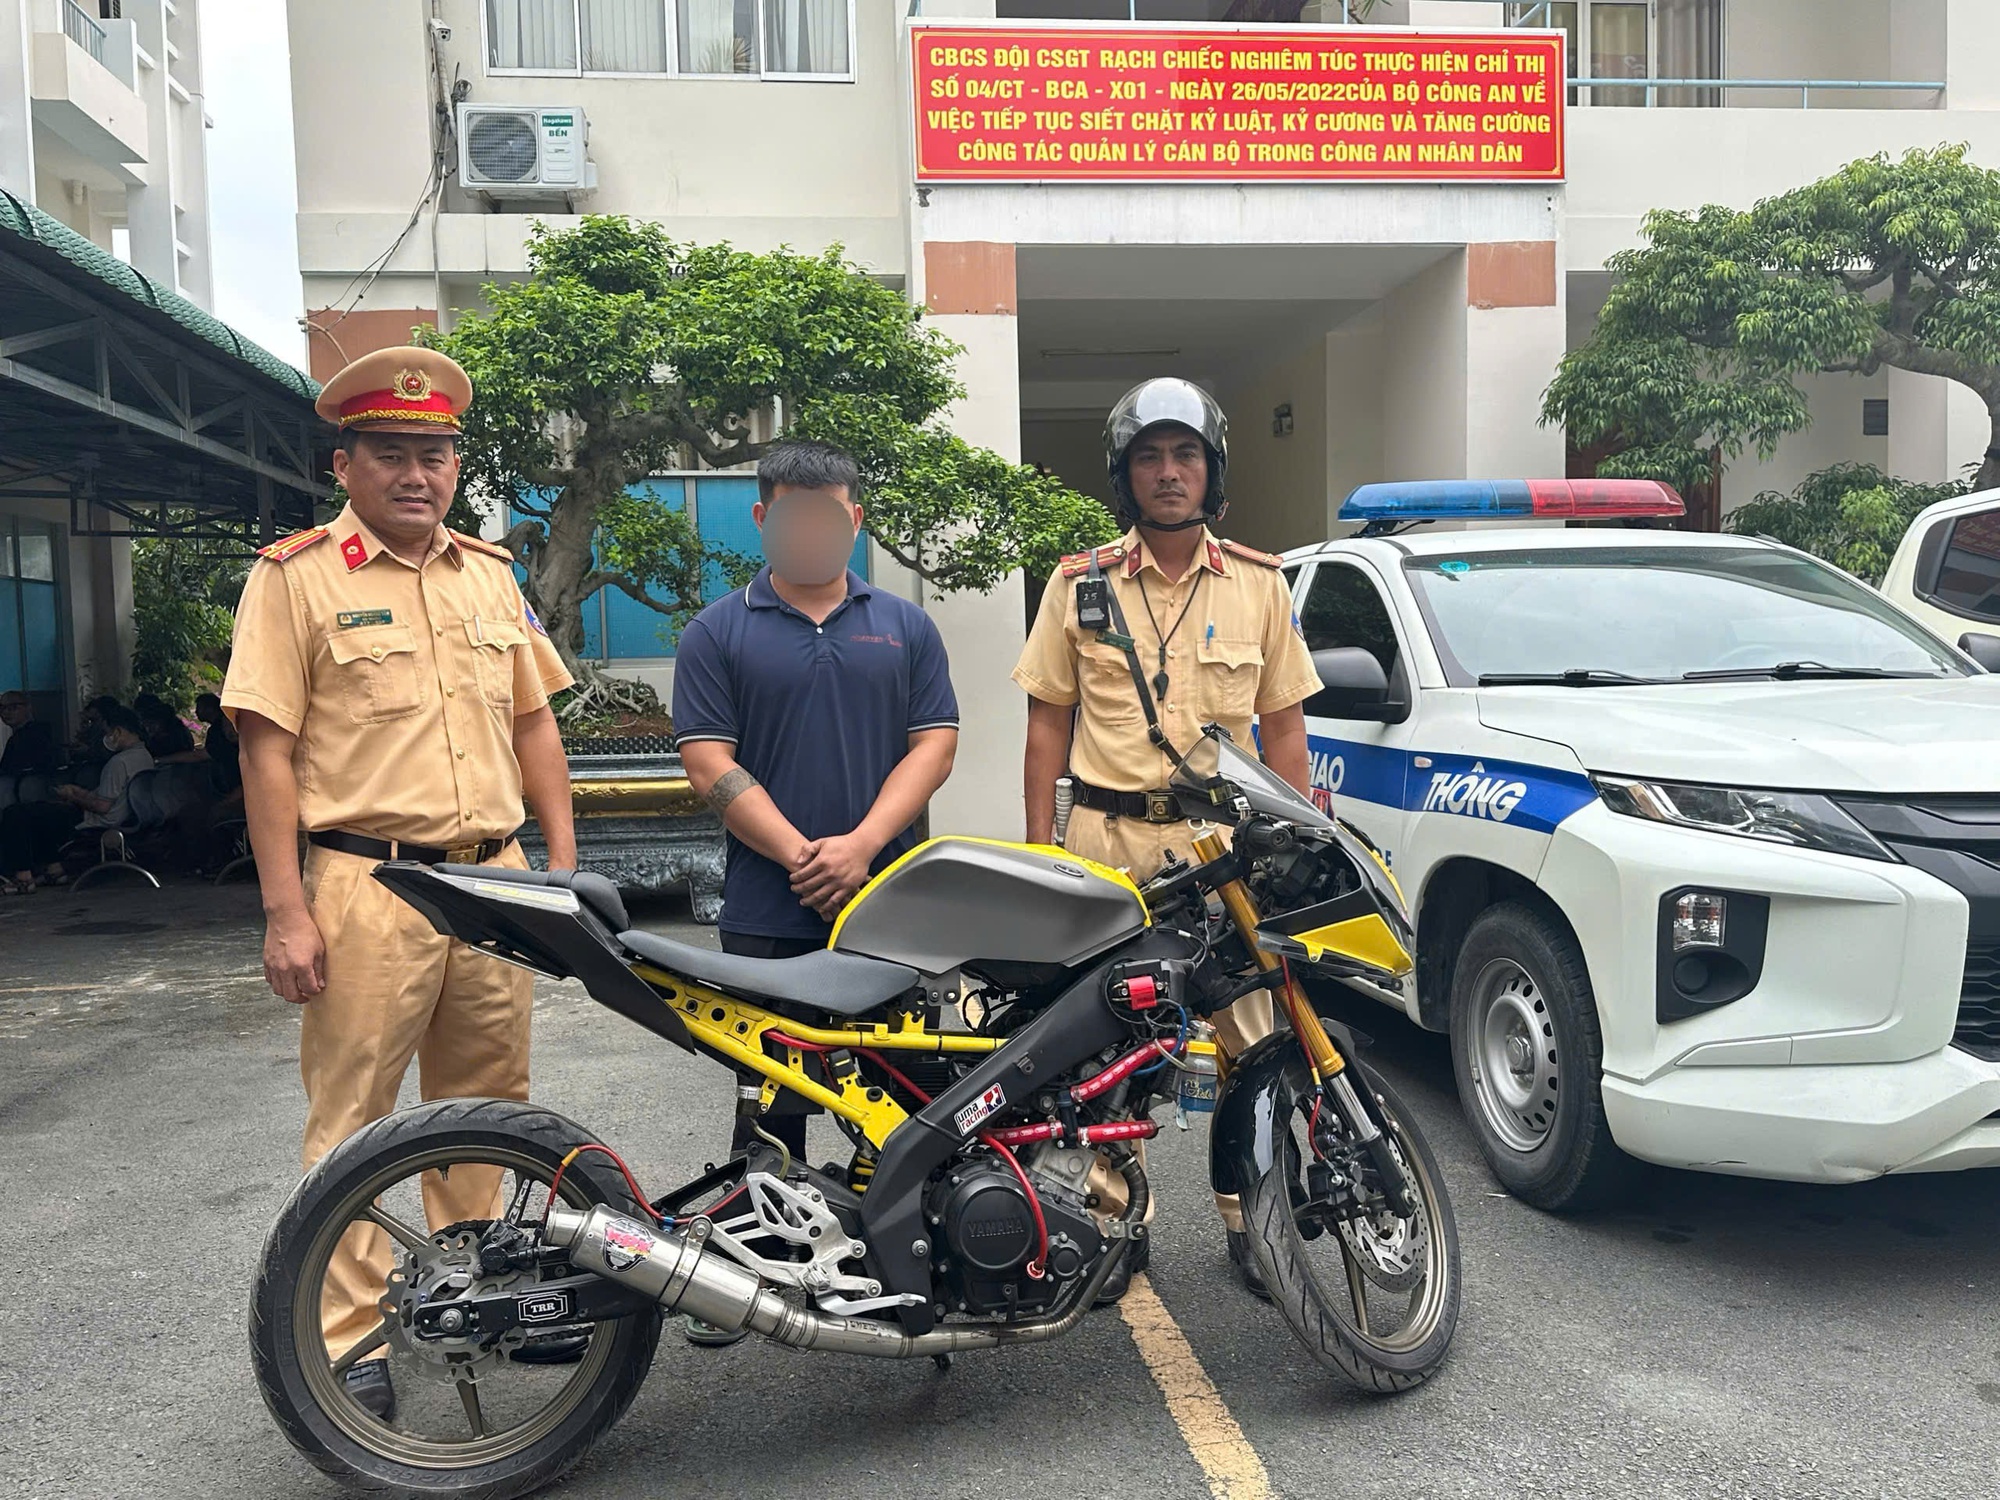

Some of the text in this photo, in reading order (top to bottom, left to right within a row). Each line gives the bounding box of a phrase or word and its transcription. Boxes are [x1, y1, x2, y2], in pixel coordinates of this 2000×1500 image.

[930, 44, 1545, 78] CBCS ĐỘI CSGT RẠCH CHIẾC NGHIÊM TÚC THỰC HIỆN CHỈ THỊ
[930, 73, 960, 99] SỐ
[965, 79, 1025, 99] 04/CT
[1045, 80, 1089, 100] BCA
[1109, 80, 1146, 100] X01
[1169, 77, 1226, 100] NGÀY
[1392, 80, 1420, 106] BỘ
[1426, 80, 1482, 103] CÔNG
[1487, 84, 1516, 103] AN
[1521, 79, 1546, 103] VỀ
[927, 106, 1551, 135] VIỆC TIẾP TỤC SIẾT CHẶT KỶ LUẬT, KỶ CƯƠNG VÀ TĂNG CƯỜNG
[958, 136, 1523, 166] CÔNG TÁC QUẢN LÝ CÁN BỘ TRONG CÔNG AN NHÂN DÂN
[1422, 761, 1527, 822] THÔNG
[957, 1102, 979, 1122] uma
[961, 1105, 989, 1130] racing
[967, 1217, 1024, 1237] YAMAHA
[530, 1302, 556, 1313] TRR
